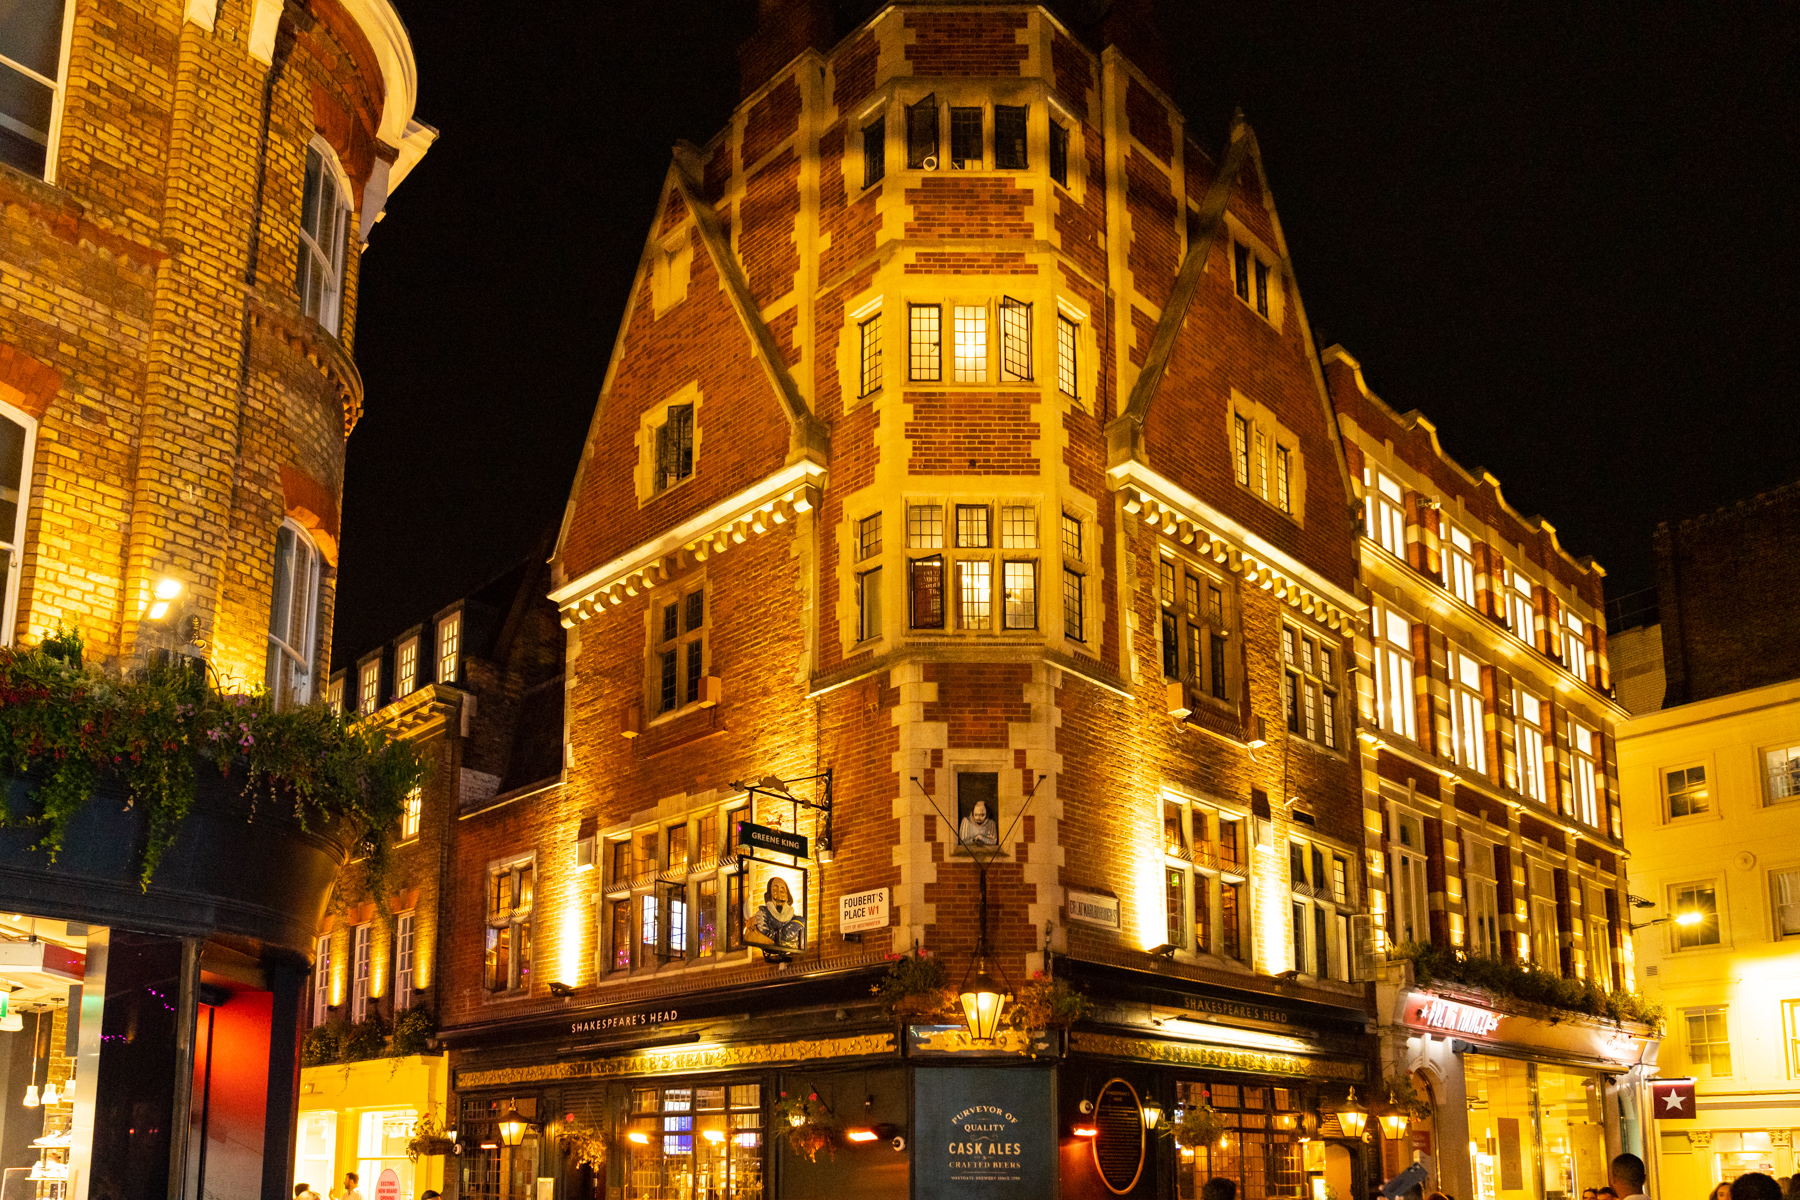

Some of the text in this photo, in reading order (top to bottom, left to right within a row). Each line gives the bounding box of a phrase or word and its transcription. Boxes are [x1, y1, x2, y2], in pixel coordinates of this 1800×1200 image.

[751, 831, 780, 845] GREENE
[781, 838, 800, 850] KING
[844, 892, 883, 908] FOUBERT'S
[844, 905, 879, 920] PLACE W1
[857, 920, 881, 928] WESTMINSTER
[1184, 998, 1287, 1023] SHAKESPEARE'S HEAD
[571, 1010, 678, 1033] SHAKESPEARE'S HEAD
[570, 1050, 713, 1075] SHAKESPEARE'S HEAD
[951, 1105, 1018, 1124] PURVEYOR OF
[964, 1124, 1005, 1132] QUALITY
[948, 1142, 1021, 1155] CASK ALES
